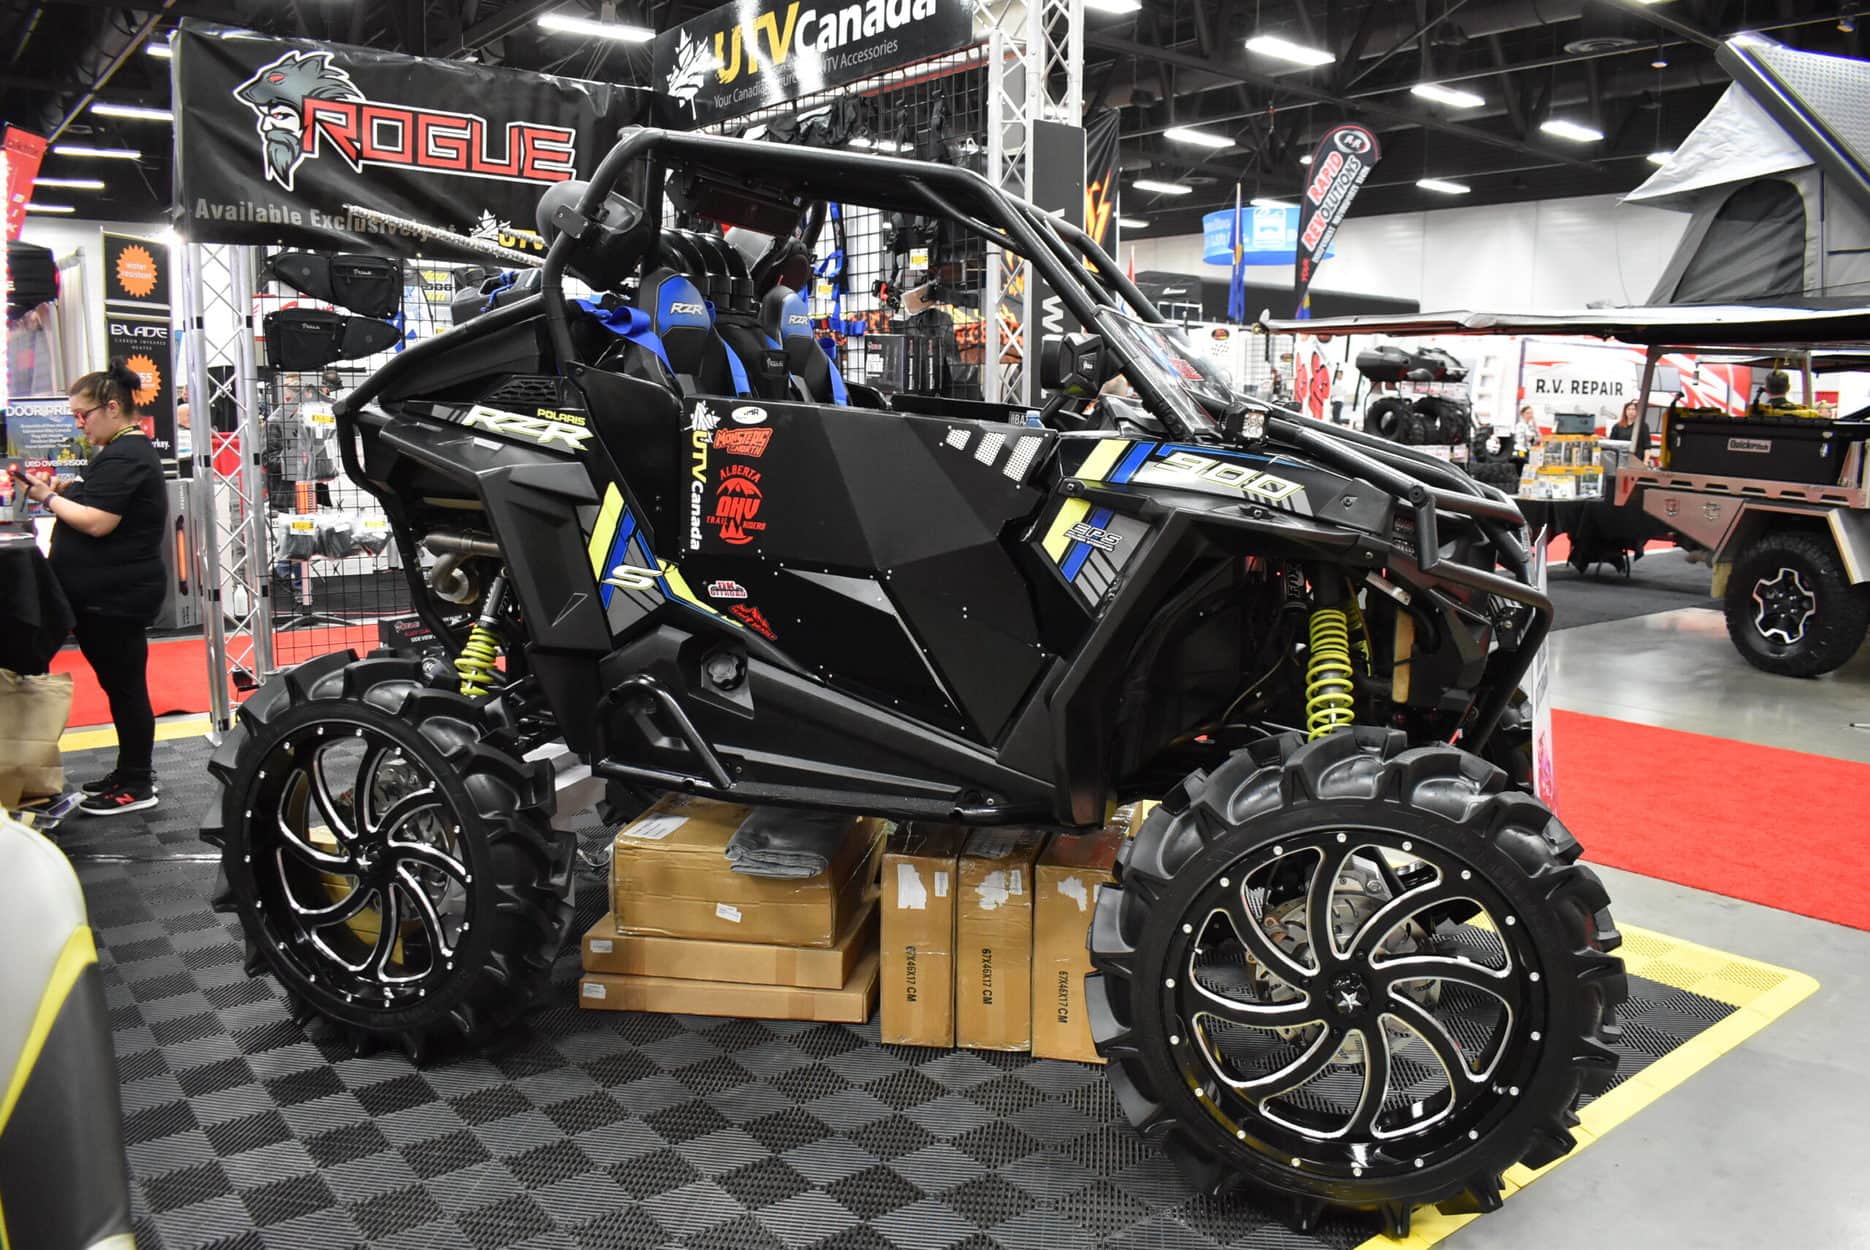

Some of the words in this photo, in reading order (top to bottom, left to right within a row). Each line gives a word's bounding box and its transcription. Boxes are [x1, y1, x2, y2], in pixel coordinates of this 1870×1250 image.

[713, 94, 733, 109] Your
[733, 81, 769, 103] Canadia
[840, 40, 898, 68] Accessories
[301, 98, 576, 184] ROGUE
[1308, 152, 1343, 205] RAPID
[195, 197, 301, 227] Available
[1302, 156, 1361, 251] REVOLUTIONS
[670, 303, 704, 316] RZR
[789, 315, 809, 326] RZR
[110, 324, 168, 339] BLADE
[1535, 378, 1565, 396] R.V.
[1571, 379, 1624, 397] REPAIR
[5, 405, 42, 417] DOOR
[47, 405, 74, 417] PRIZ
[537, 408, 586, 426] POLARIS
[462, 404, 594, 451] RZR
[720, 464, 762, 483] ALBERTA
[706, 516, 728, 525] TRAIL
[981, 948, 992, 988] 67X46X17
[906, 986, 917, 1002] CM
[982, 989, 993, 1005] CM
[1057, 1008, 1069, 1024] CM
